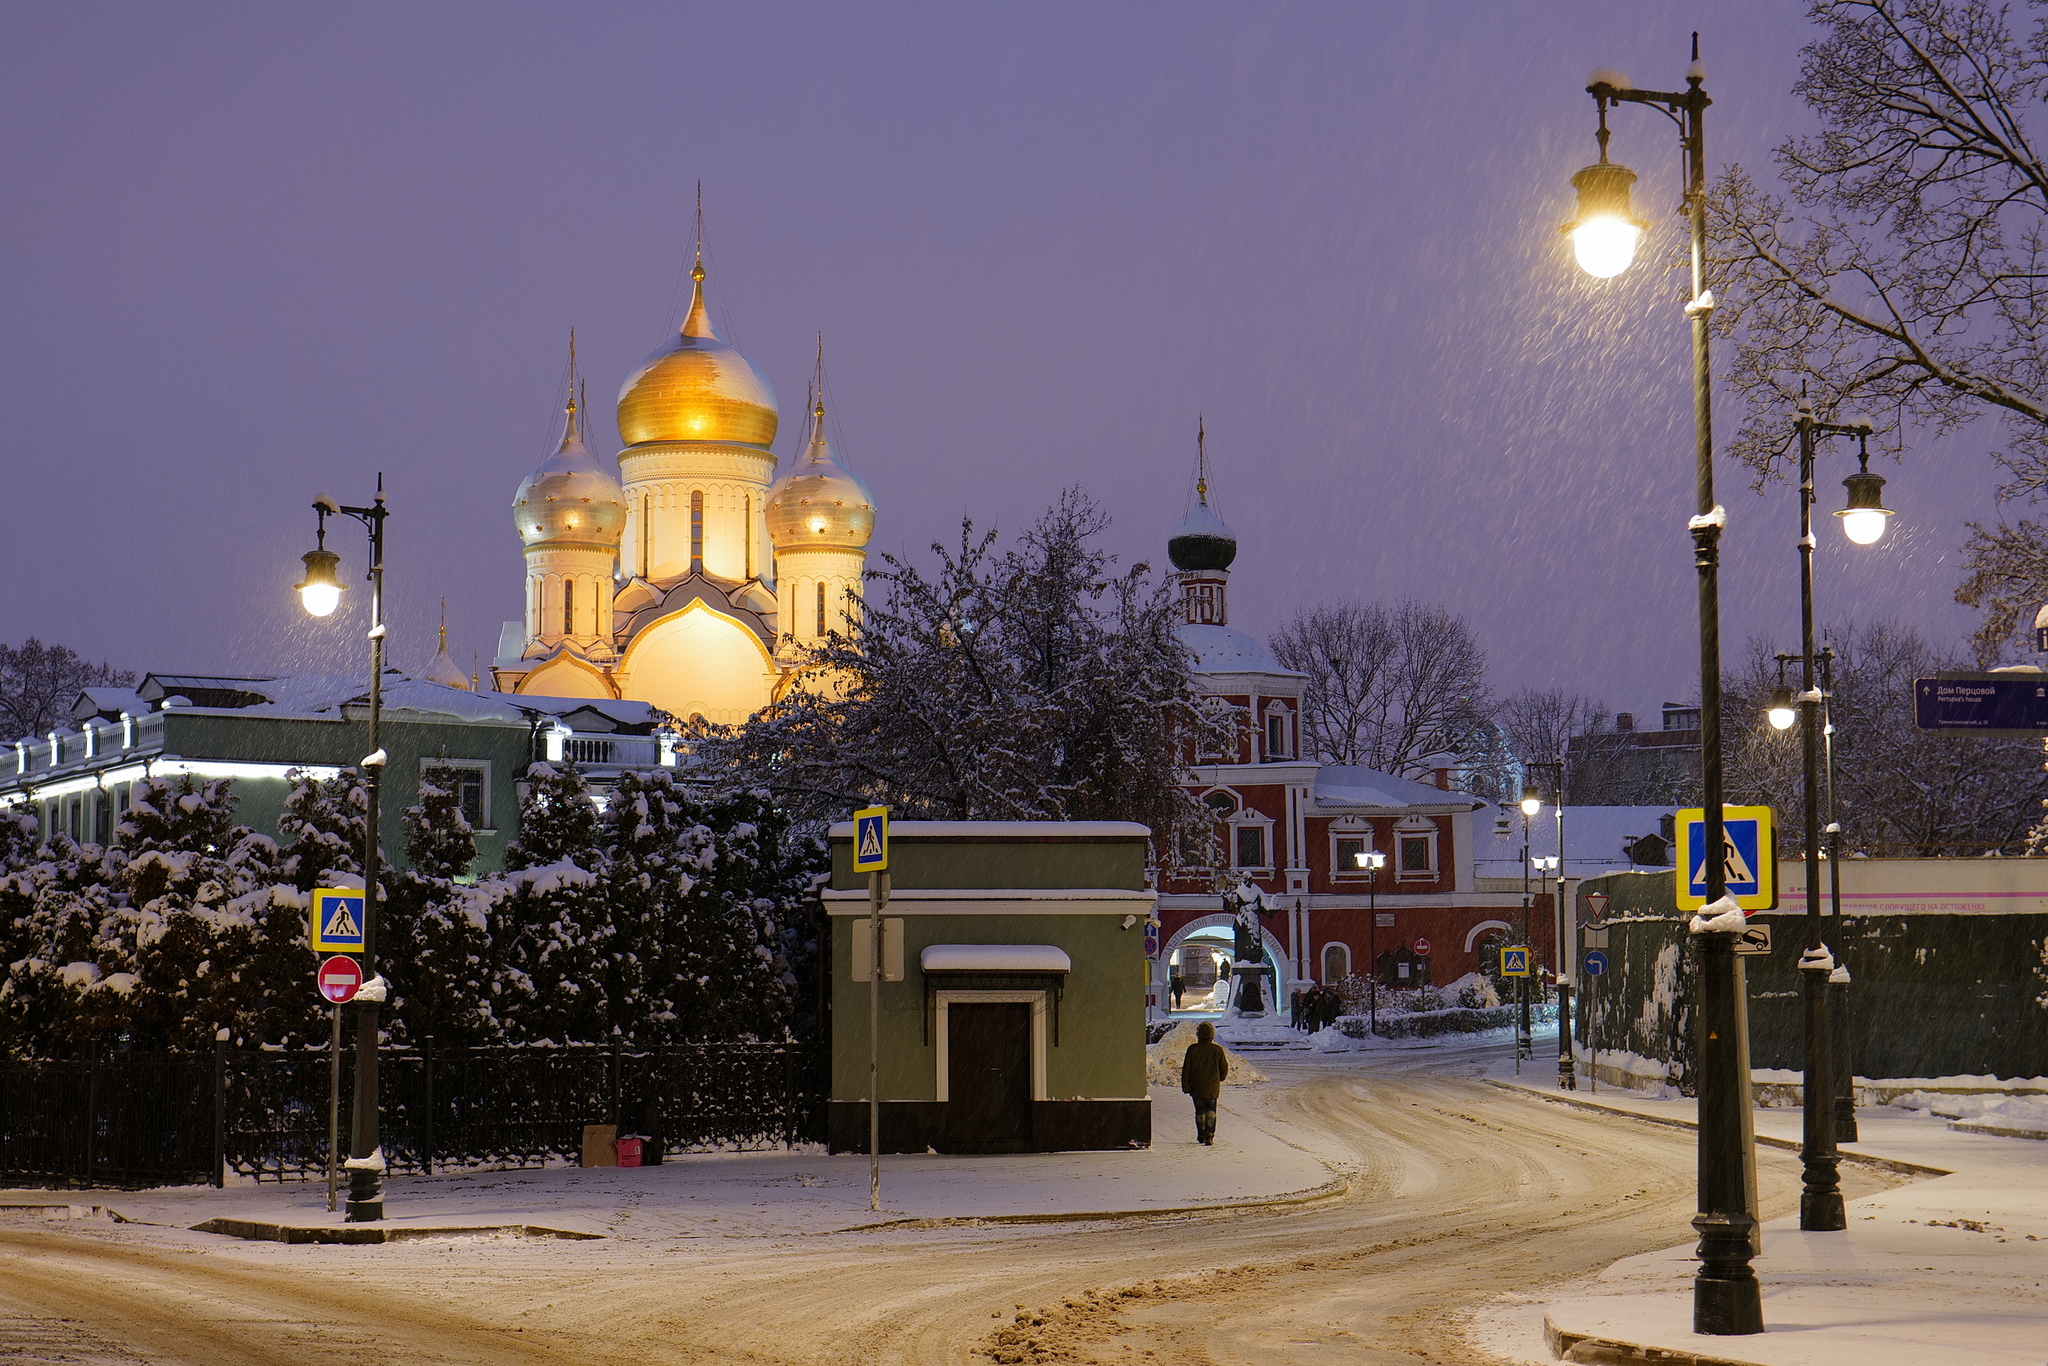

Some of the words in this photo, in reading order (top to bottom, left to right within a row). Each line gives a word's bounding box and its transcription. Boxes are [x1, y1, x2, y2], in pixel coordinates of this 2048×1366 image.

[1937, 687, 1954, 695] Дом
[1956, 686, 1996, 696] Перцовой
[1940, 902, 1986, 911] ОСТОЖЕНКЕ
